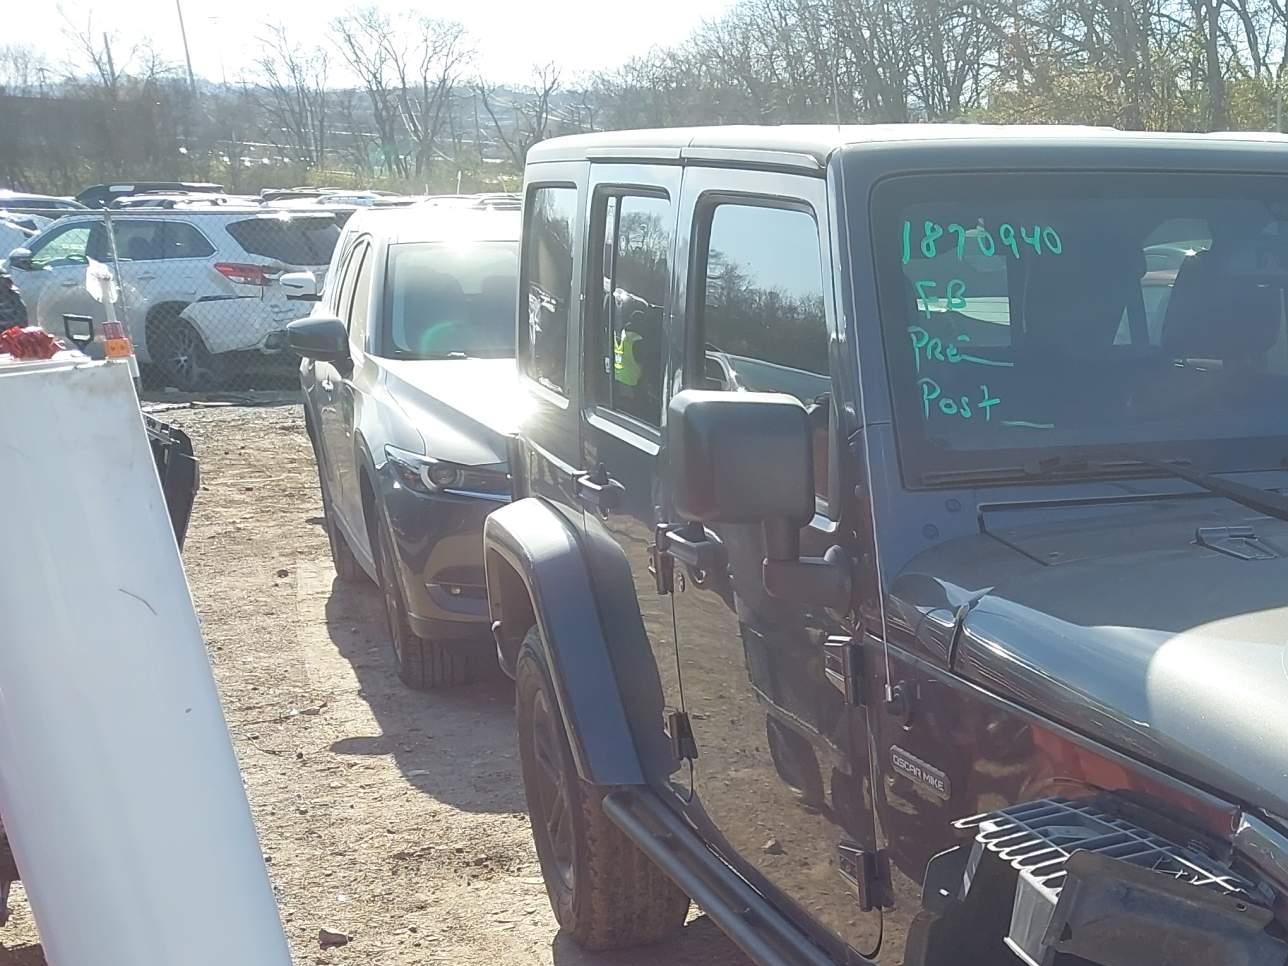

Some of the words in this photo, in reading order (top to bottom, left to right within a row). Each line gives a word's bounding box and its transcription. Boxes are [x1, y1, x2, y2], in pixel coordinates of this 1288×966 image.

[902, 219, 1062, 264] 1870940
[893, 754, 922, 779] OSCAR
[922, 771, 945, 792] MIKE
